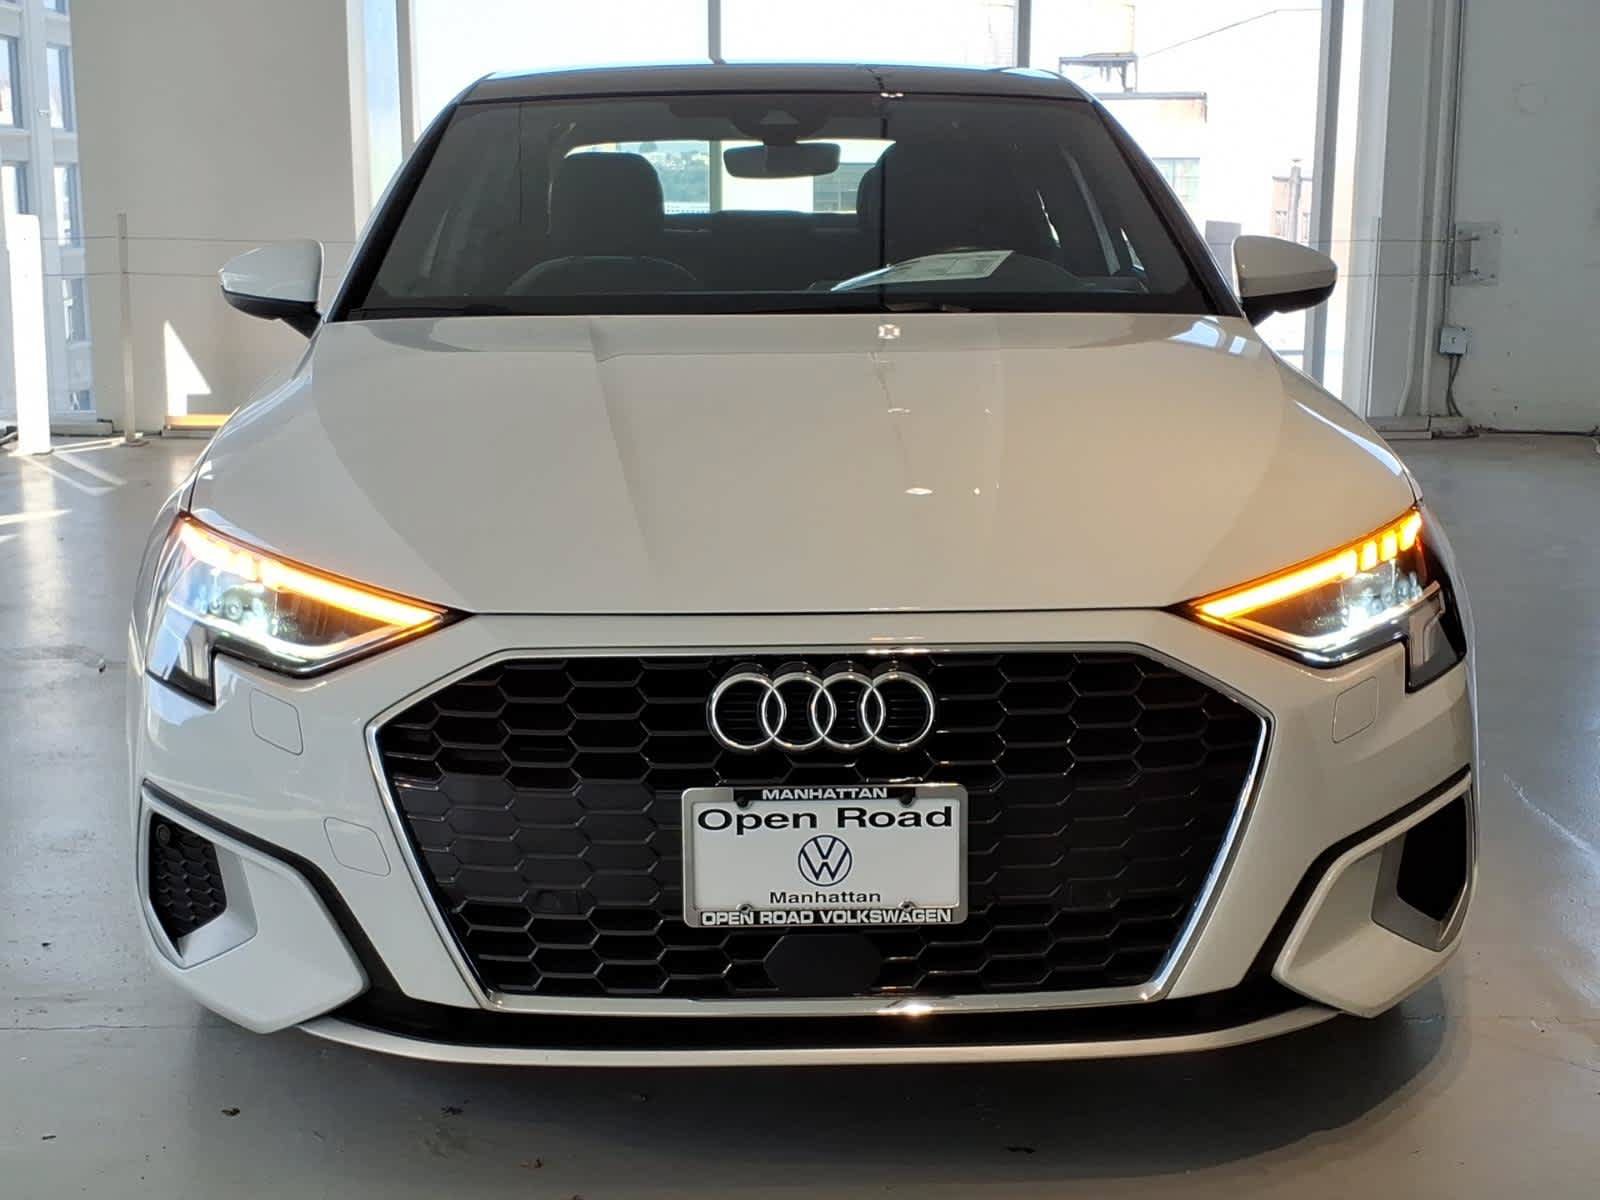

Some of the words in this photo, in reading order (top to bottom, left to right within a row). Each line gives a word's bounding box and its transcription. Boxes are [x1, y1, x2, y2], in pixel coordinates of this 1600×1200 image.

[762, 787, 888, 801] MANHATTAN
[697, 808, 818, 836] Open
[836, 806, 953, 829] Road
[769, 891, 881, 904] Manhattan
[701, 910, 754, 926] OPEN
[759, 910, 814, 925] ROAD
[820, 908, 952, 924] VOLKSWAGEN
